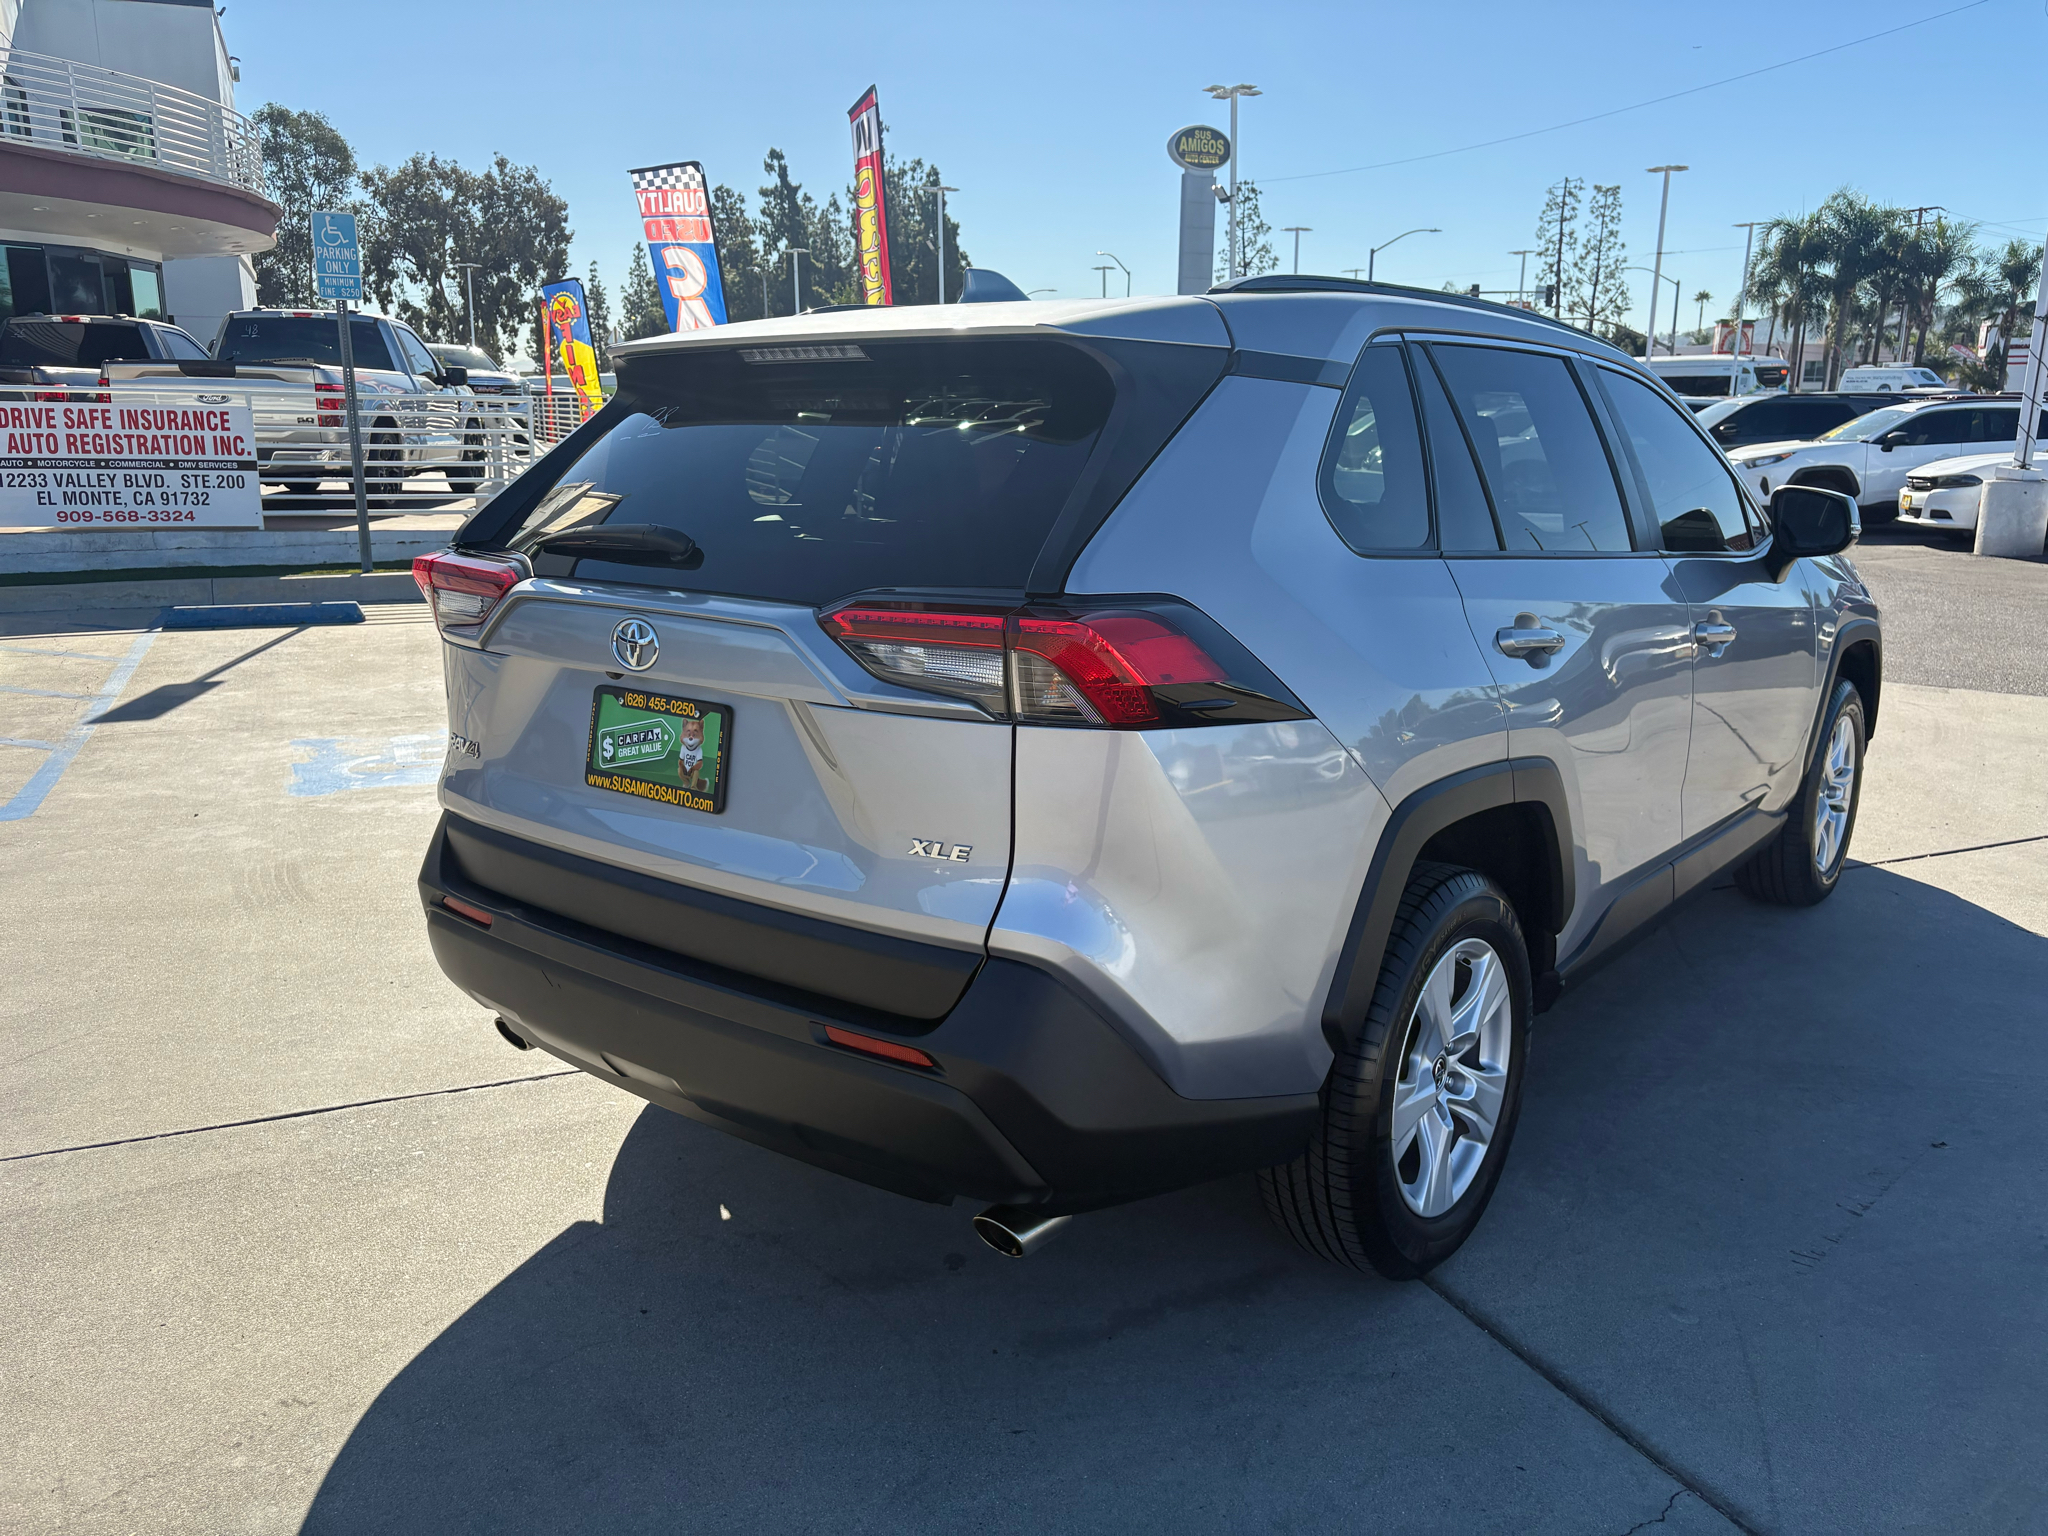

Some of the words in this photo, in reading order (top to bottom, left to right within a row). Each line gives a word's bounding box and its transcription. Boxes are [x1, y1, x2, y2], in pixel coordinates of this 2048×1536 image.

[1194, 130, 1211, 140] SUS
[1179, 136, 1224, 155] AMIGOS
[1185, 153, 1198, 163] AUTO
[1200, 155, 1219, 164] CENTER
[317, 246, 357, 261] PARKING
[325, 261, 350, 273] ONLY
[324, 277, 354, 287] MINIMUM
[321, 286, 336, 296] FINE
[0, 407, 57, 429] DRIVE
[63, 407, 113, 430] SAFE
[119, 409, 231, 432] INSURANCE
[7, 432, 59, 455] AUTO
[65, 433, 206, 456] REGISTRATION
[213, 435, 252, 457] INC.
[37, 460, 96, 468] MOTORCYCLE
[109, 461, 166, 469] COMMERCIAL
[178, 461, 196, 469] DMV
[198, 461, 238, 469] SERVICES
[52, 473, 117, 488] VALLEY
[124, 473, 171, 489] BLVD.
[181, 474, 245, 489] STE.200
[37, 491, 57, 506] EL
[63, 491, 128, 508] MONTE,
[133, 491, 155, 506] CA
[160, 491, 210, 507] 91732
[56, 510, 196, 523] 909-568-3324
[624, 691, 647, 709] (626)
[648, 696, 695, 716] 455-0250
[618, 728, 661, 746] CARFAX
[618, 746, 639, 757] GREAT
[640, 742, 662, 754] VALUE
[588, 774, 714, 812] www.SUSAMIGOSAUTO.com
[907, 838, 973, 863] XLE
